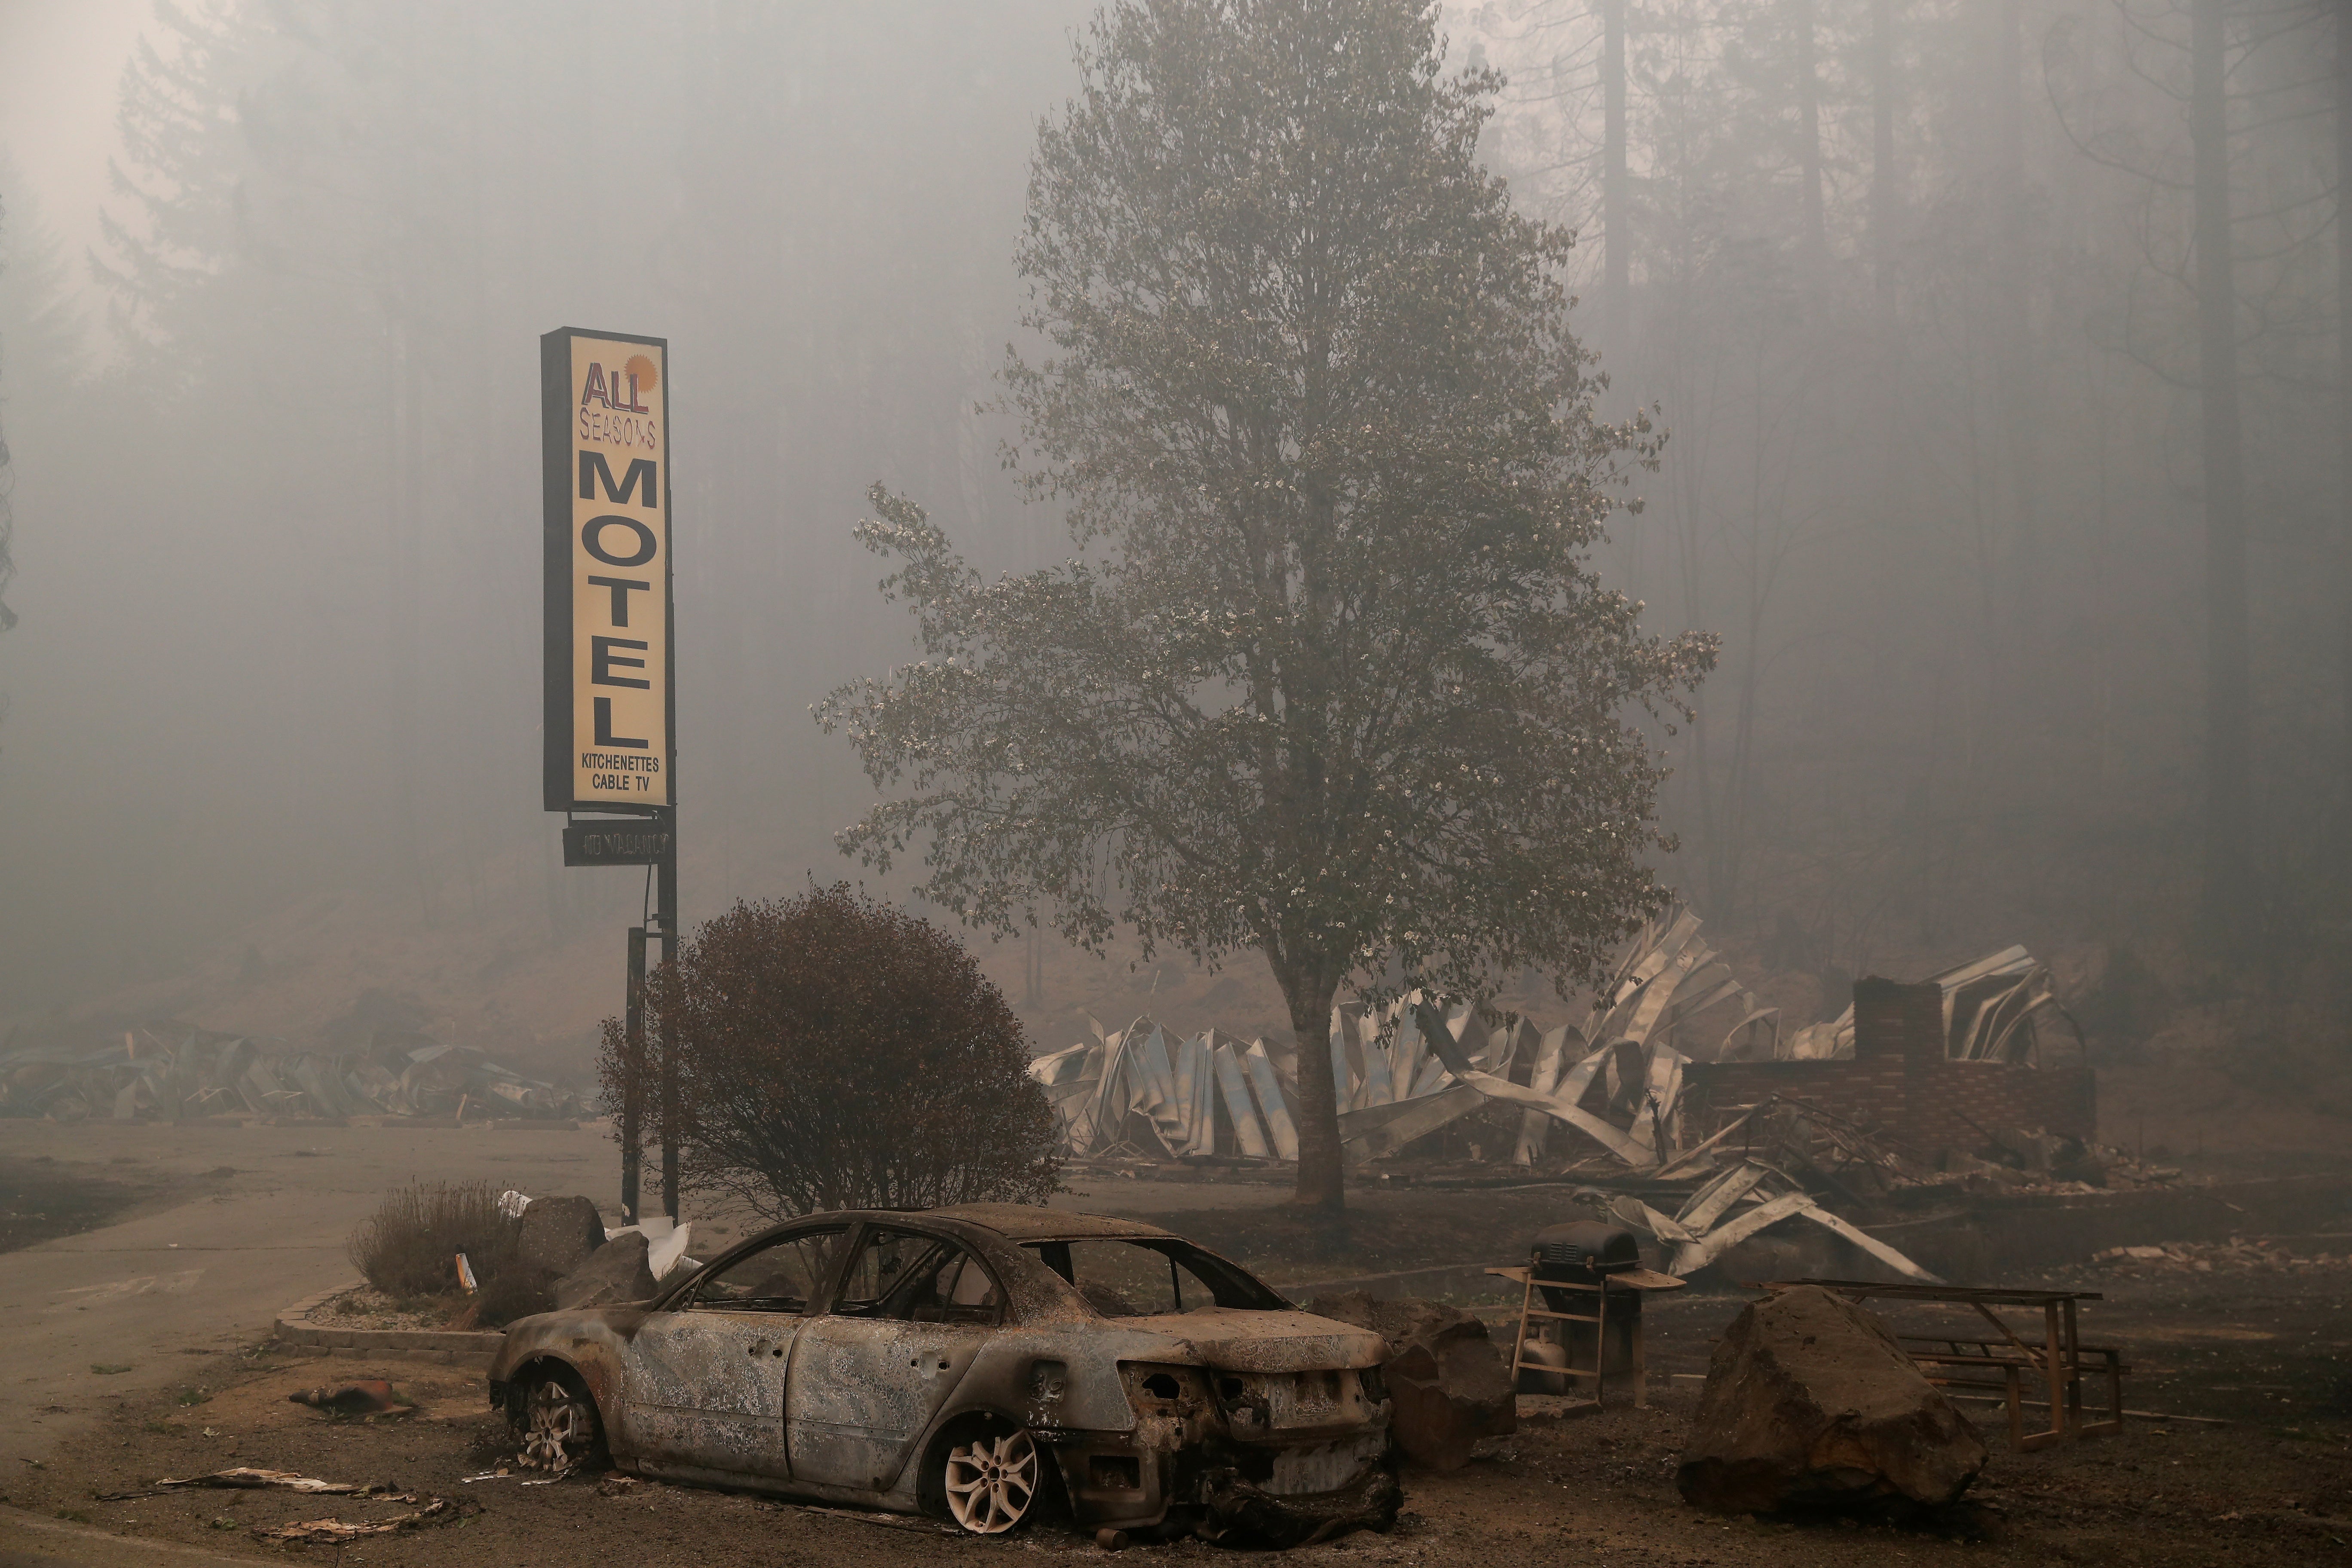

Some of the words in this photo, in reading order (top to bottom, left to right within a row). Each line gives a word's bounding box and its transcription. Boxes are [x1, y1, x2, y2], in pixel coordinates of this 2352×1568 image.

[582, 362, 649, 414] ALL
[579, 407, 656, 449] SEASONS
[579, 450, 657, 749] MOTEL
[582, 753, 659, 773] KITCHENETTES
[592, 773, 630, 791] CABLE
[636, 775, 650, 792] TV
[584, 835, 601, 855] NO
